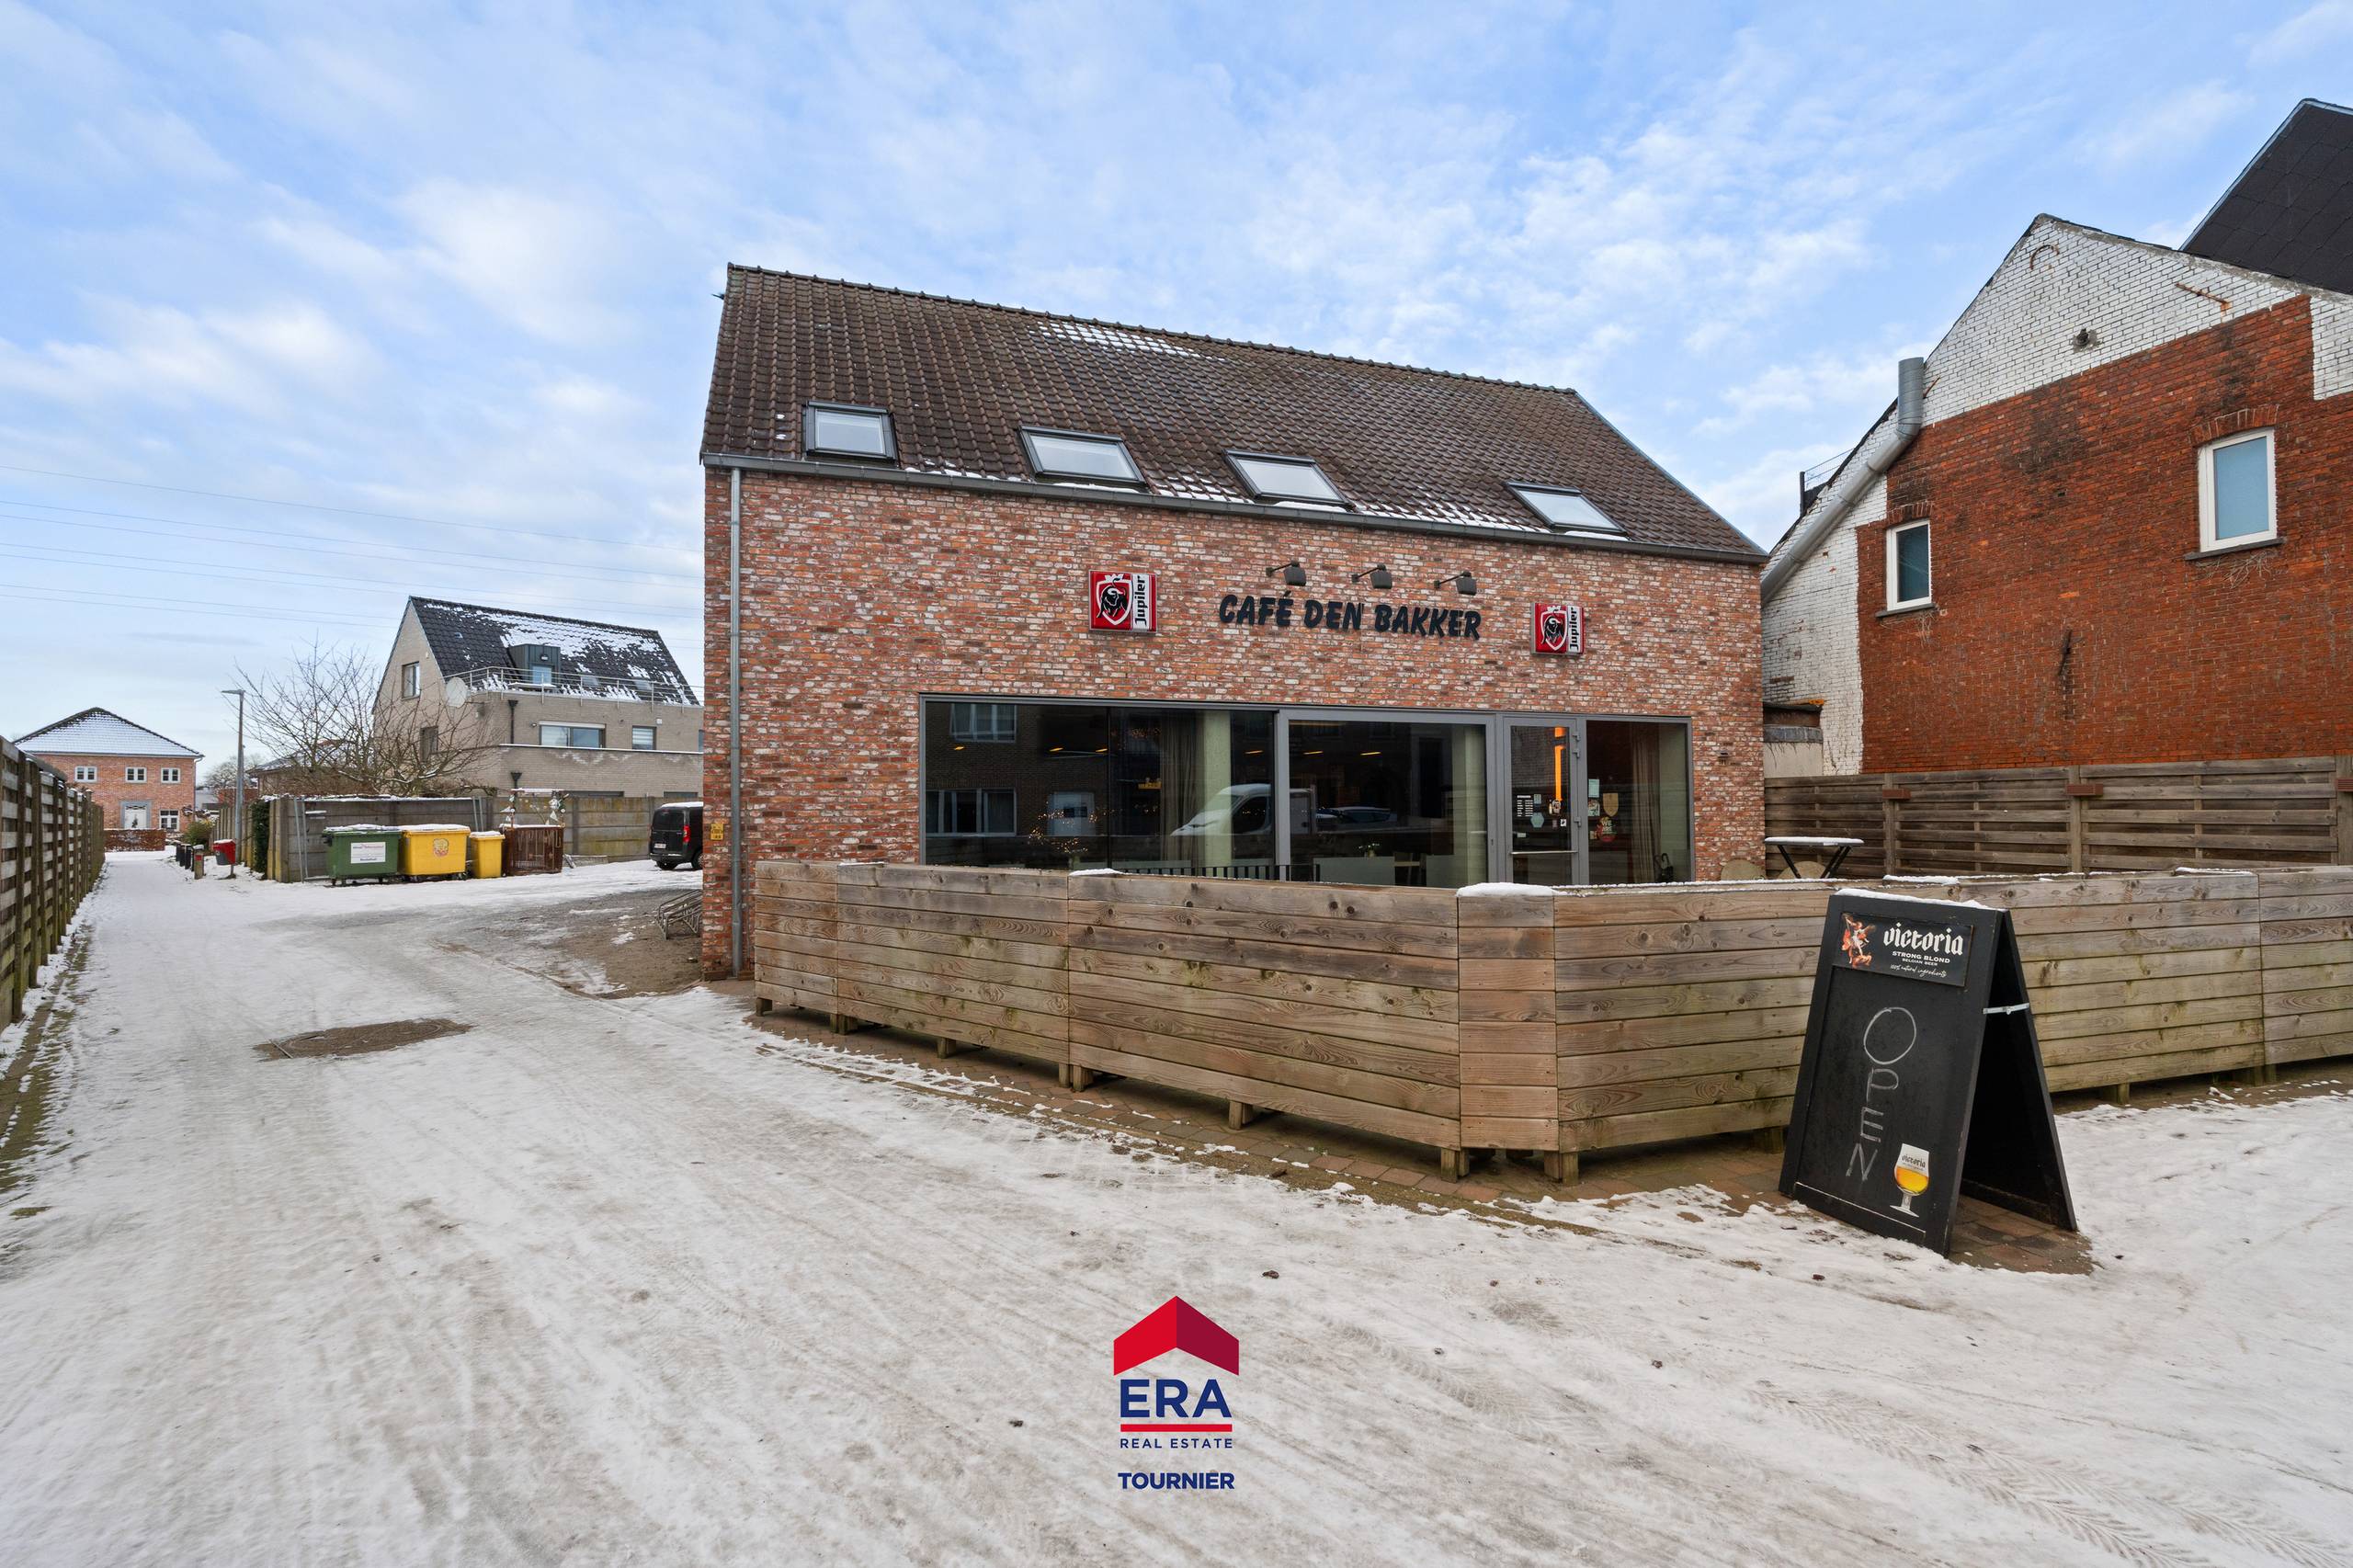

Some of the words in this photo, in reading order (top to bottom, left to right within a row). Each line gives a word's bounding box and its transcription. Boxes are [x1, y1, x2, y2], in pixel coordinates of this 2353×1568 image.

[1134, 575, 1148, 626] Jupiler
[1219, 590, 1293, 627] CAFÉ
[1303, 599, 1364, 631] DEN
[1374, 604, 1482, 641] BAKKER
[1569, 607, 1580, 652] Jupiler
[1883, 922, 1963, 956] victoria
[1892, 951, 1922, 960] STRONG
[1924, 955, 1950, 963] BLOND
[1845, 1006, 1917, 1182] OPEN
[1902, 1154, 1926, 1168] victoria
